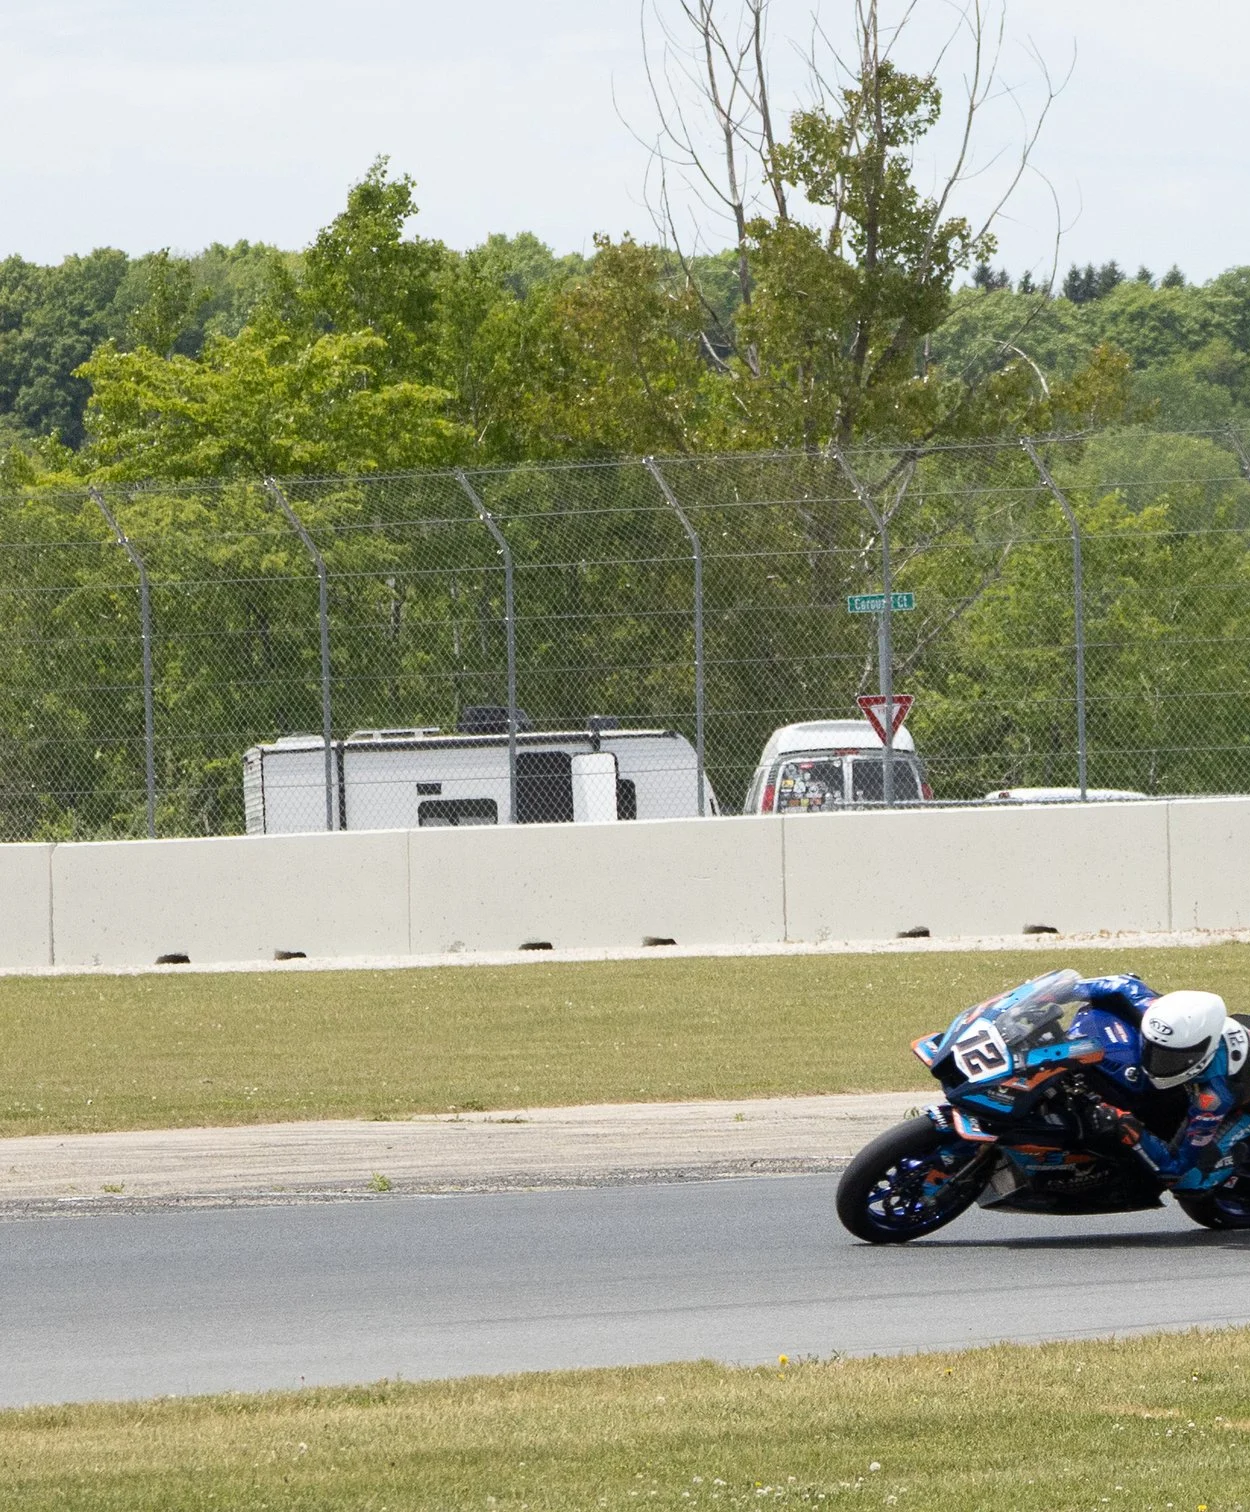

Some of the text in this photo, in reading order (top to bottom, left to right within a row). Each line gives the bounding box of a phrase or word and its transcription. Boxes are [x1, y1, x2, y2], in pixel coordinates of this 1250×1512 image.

[855, 595, 908, 610] Carousl Ct
[1150, 1019, 1170, 1035] KYT
[1227, 1028, 1245, 1047] 12
[955, 1029, 1006, 1076] 12
